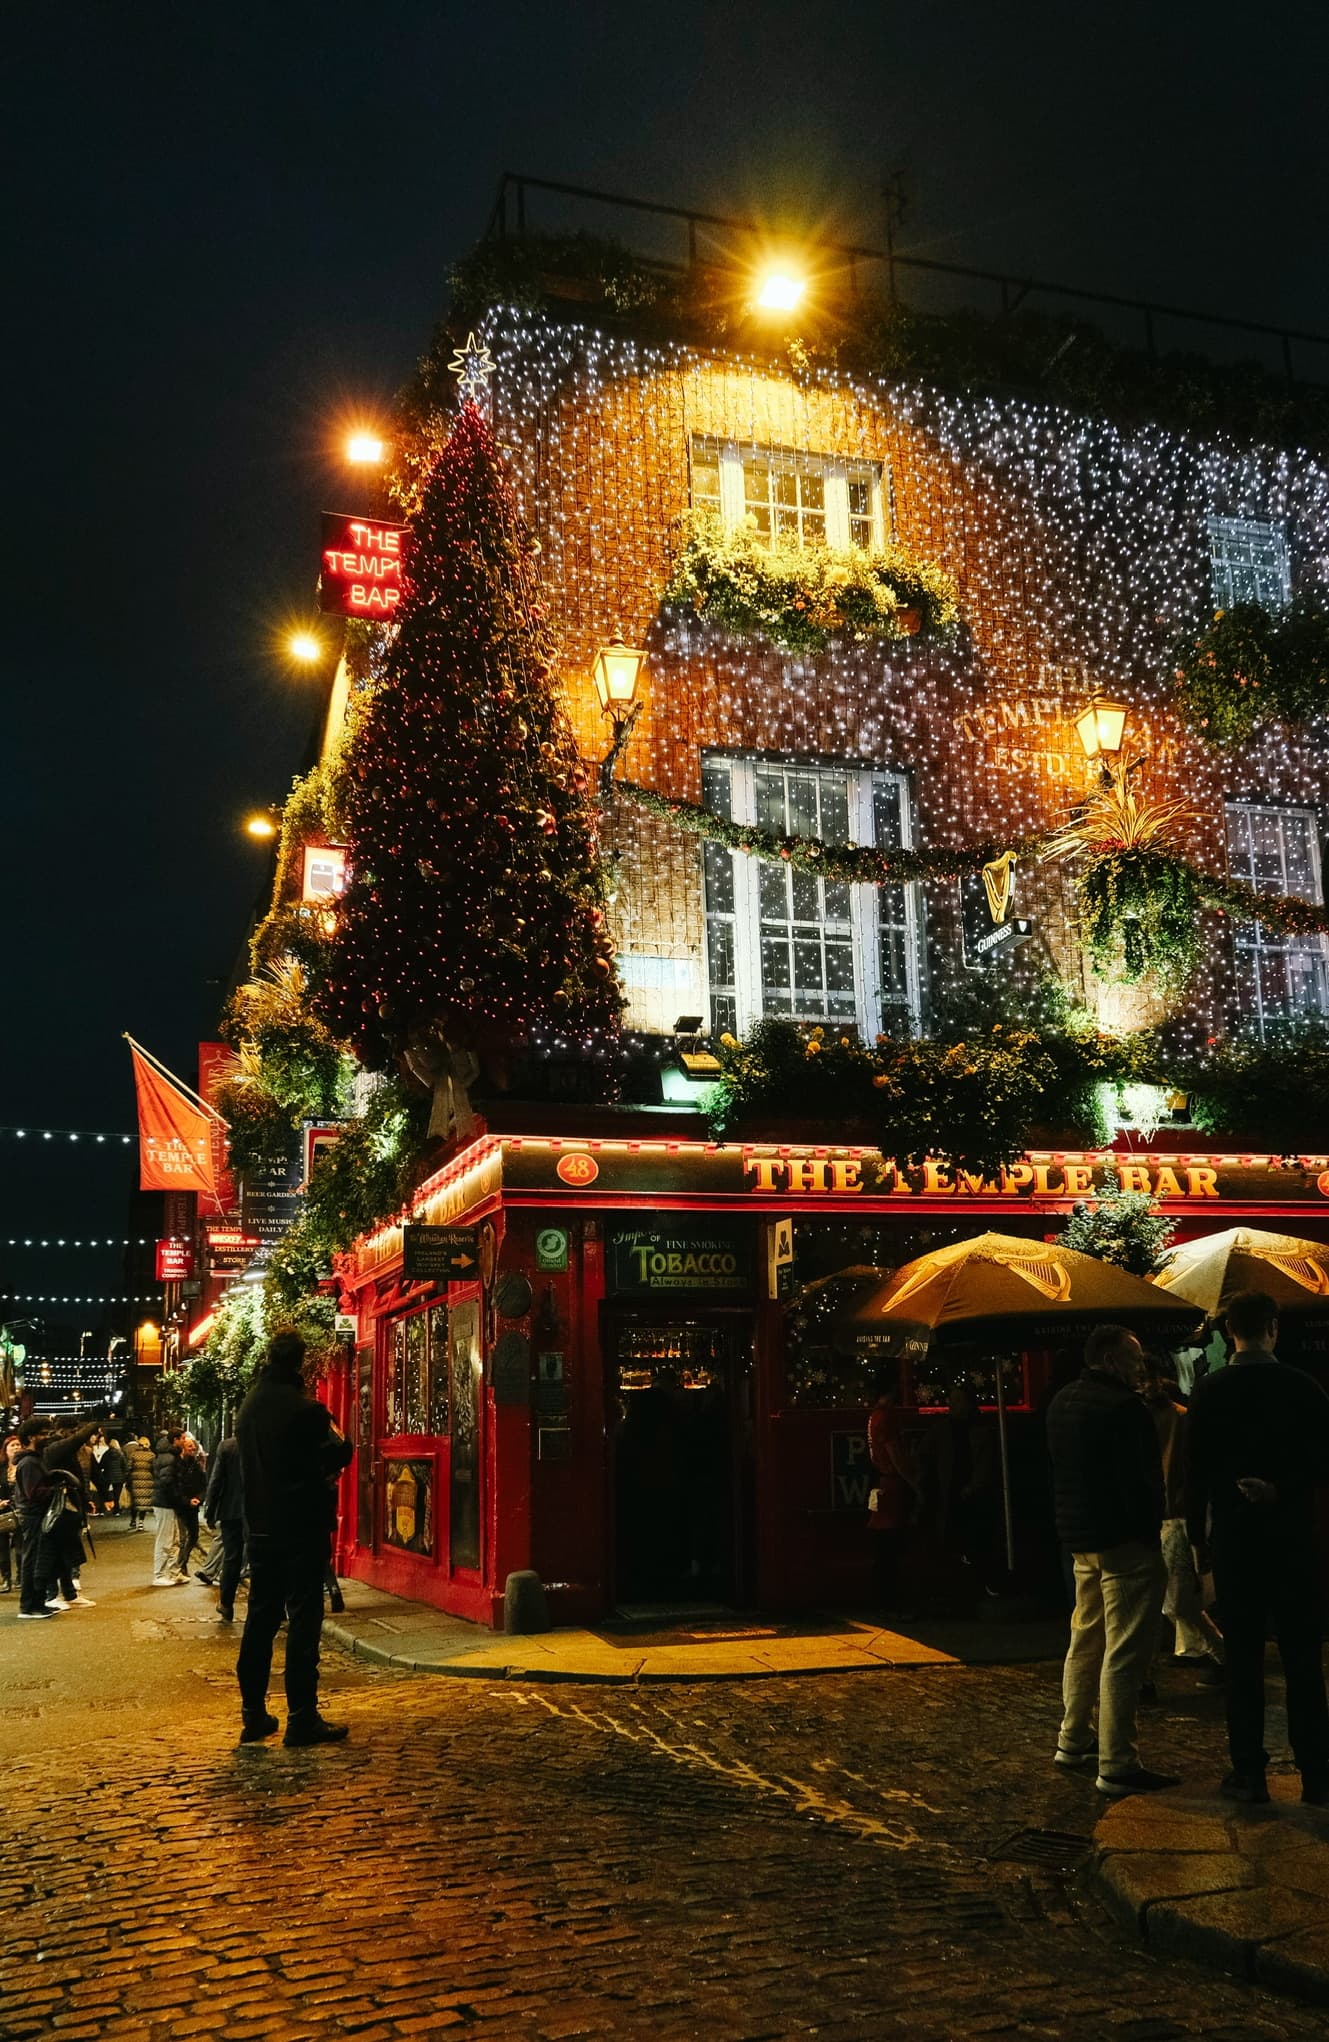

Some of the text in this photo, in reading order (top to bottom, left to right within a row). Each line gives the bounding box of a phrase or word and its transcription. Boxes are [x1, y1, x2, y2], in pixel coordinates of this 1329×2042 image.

[350, 523, 400, 552] THE
[325, 550, 402, 579] TEMPL
[351, 583, 401, 608] BAR
[952, 696, 1073, 744] TEMPL
[977, 925, 1012, 953] GUINNESS
[146, 1150, 207, 1165] TEMPLE
[163, 1162, 194, 1174] BAR
[564, 1157, 590, 1178] 48
[747, 1158, 865, 1193] THE
[1116, 1165, 1220, 1198] BAR
[266, 1191, 297, 1199] GARDEN
[268, 1218, 295, 1226] MUSIC
[161, 1249, 191, 1257] TEMPLE
[666, 1240, 735, 1249] FINE SMOKIN
[631, 1245, 737, 1281] TOBACCO
[652, 1278, 693, 1288] Always
